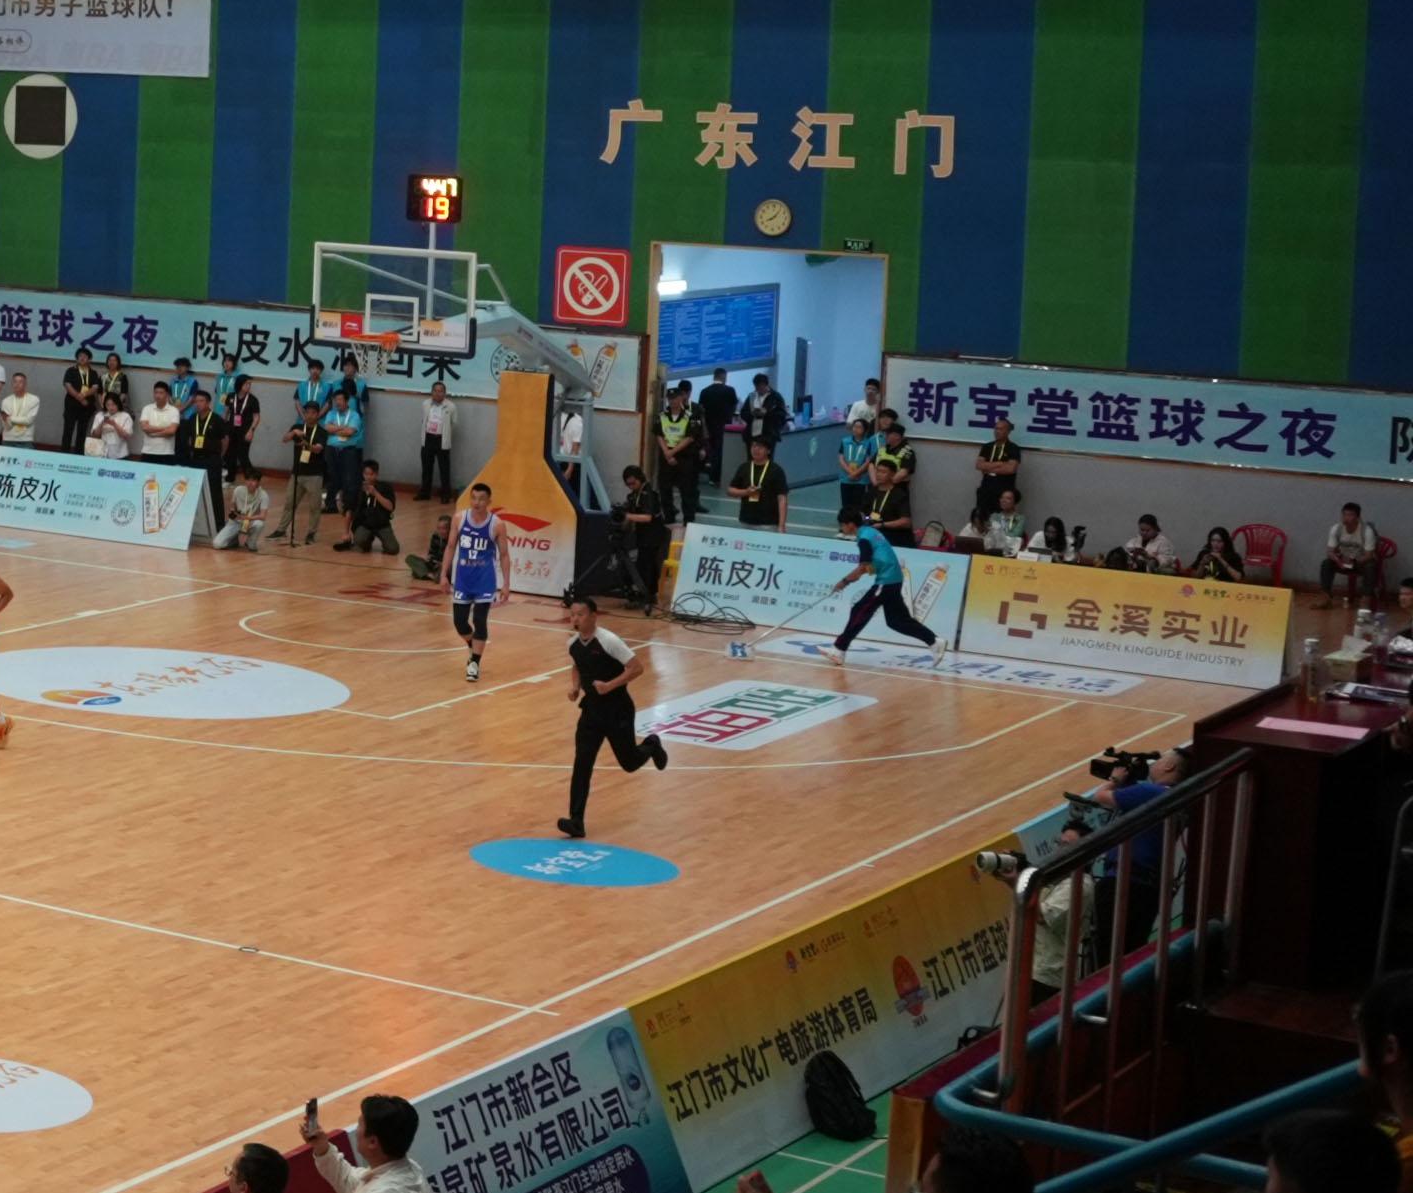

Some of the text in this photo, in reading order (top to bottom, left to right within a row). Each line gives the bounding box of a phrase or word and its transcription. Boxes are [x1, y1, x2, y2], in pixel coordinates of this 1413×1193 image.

[599, 100, 955, 178] 广东江门
[425, 197, 450, 220] 19
[192, 320, 312, 368] 陈皮水
[908, 378, 1338, 459] 新宝堂篮球之夜
[696, 556, 784, 591] 陈皮水
[1065, 598, 1249, 649] 金溪实业
[1061, 637, 1244, 666] JIANGMEN KINGUIDE INDUSTRY
[666, 987, 878, 1122] 江门市文化广电旅游体育局
[433, 1051, 581, 1155] 江门市新会区
